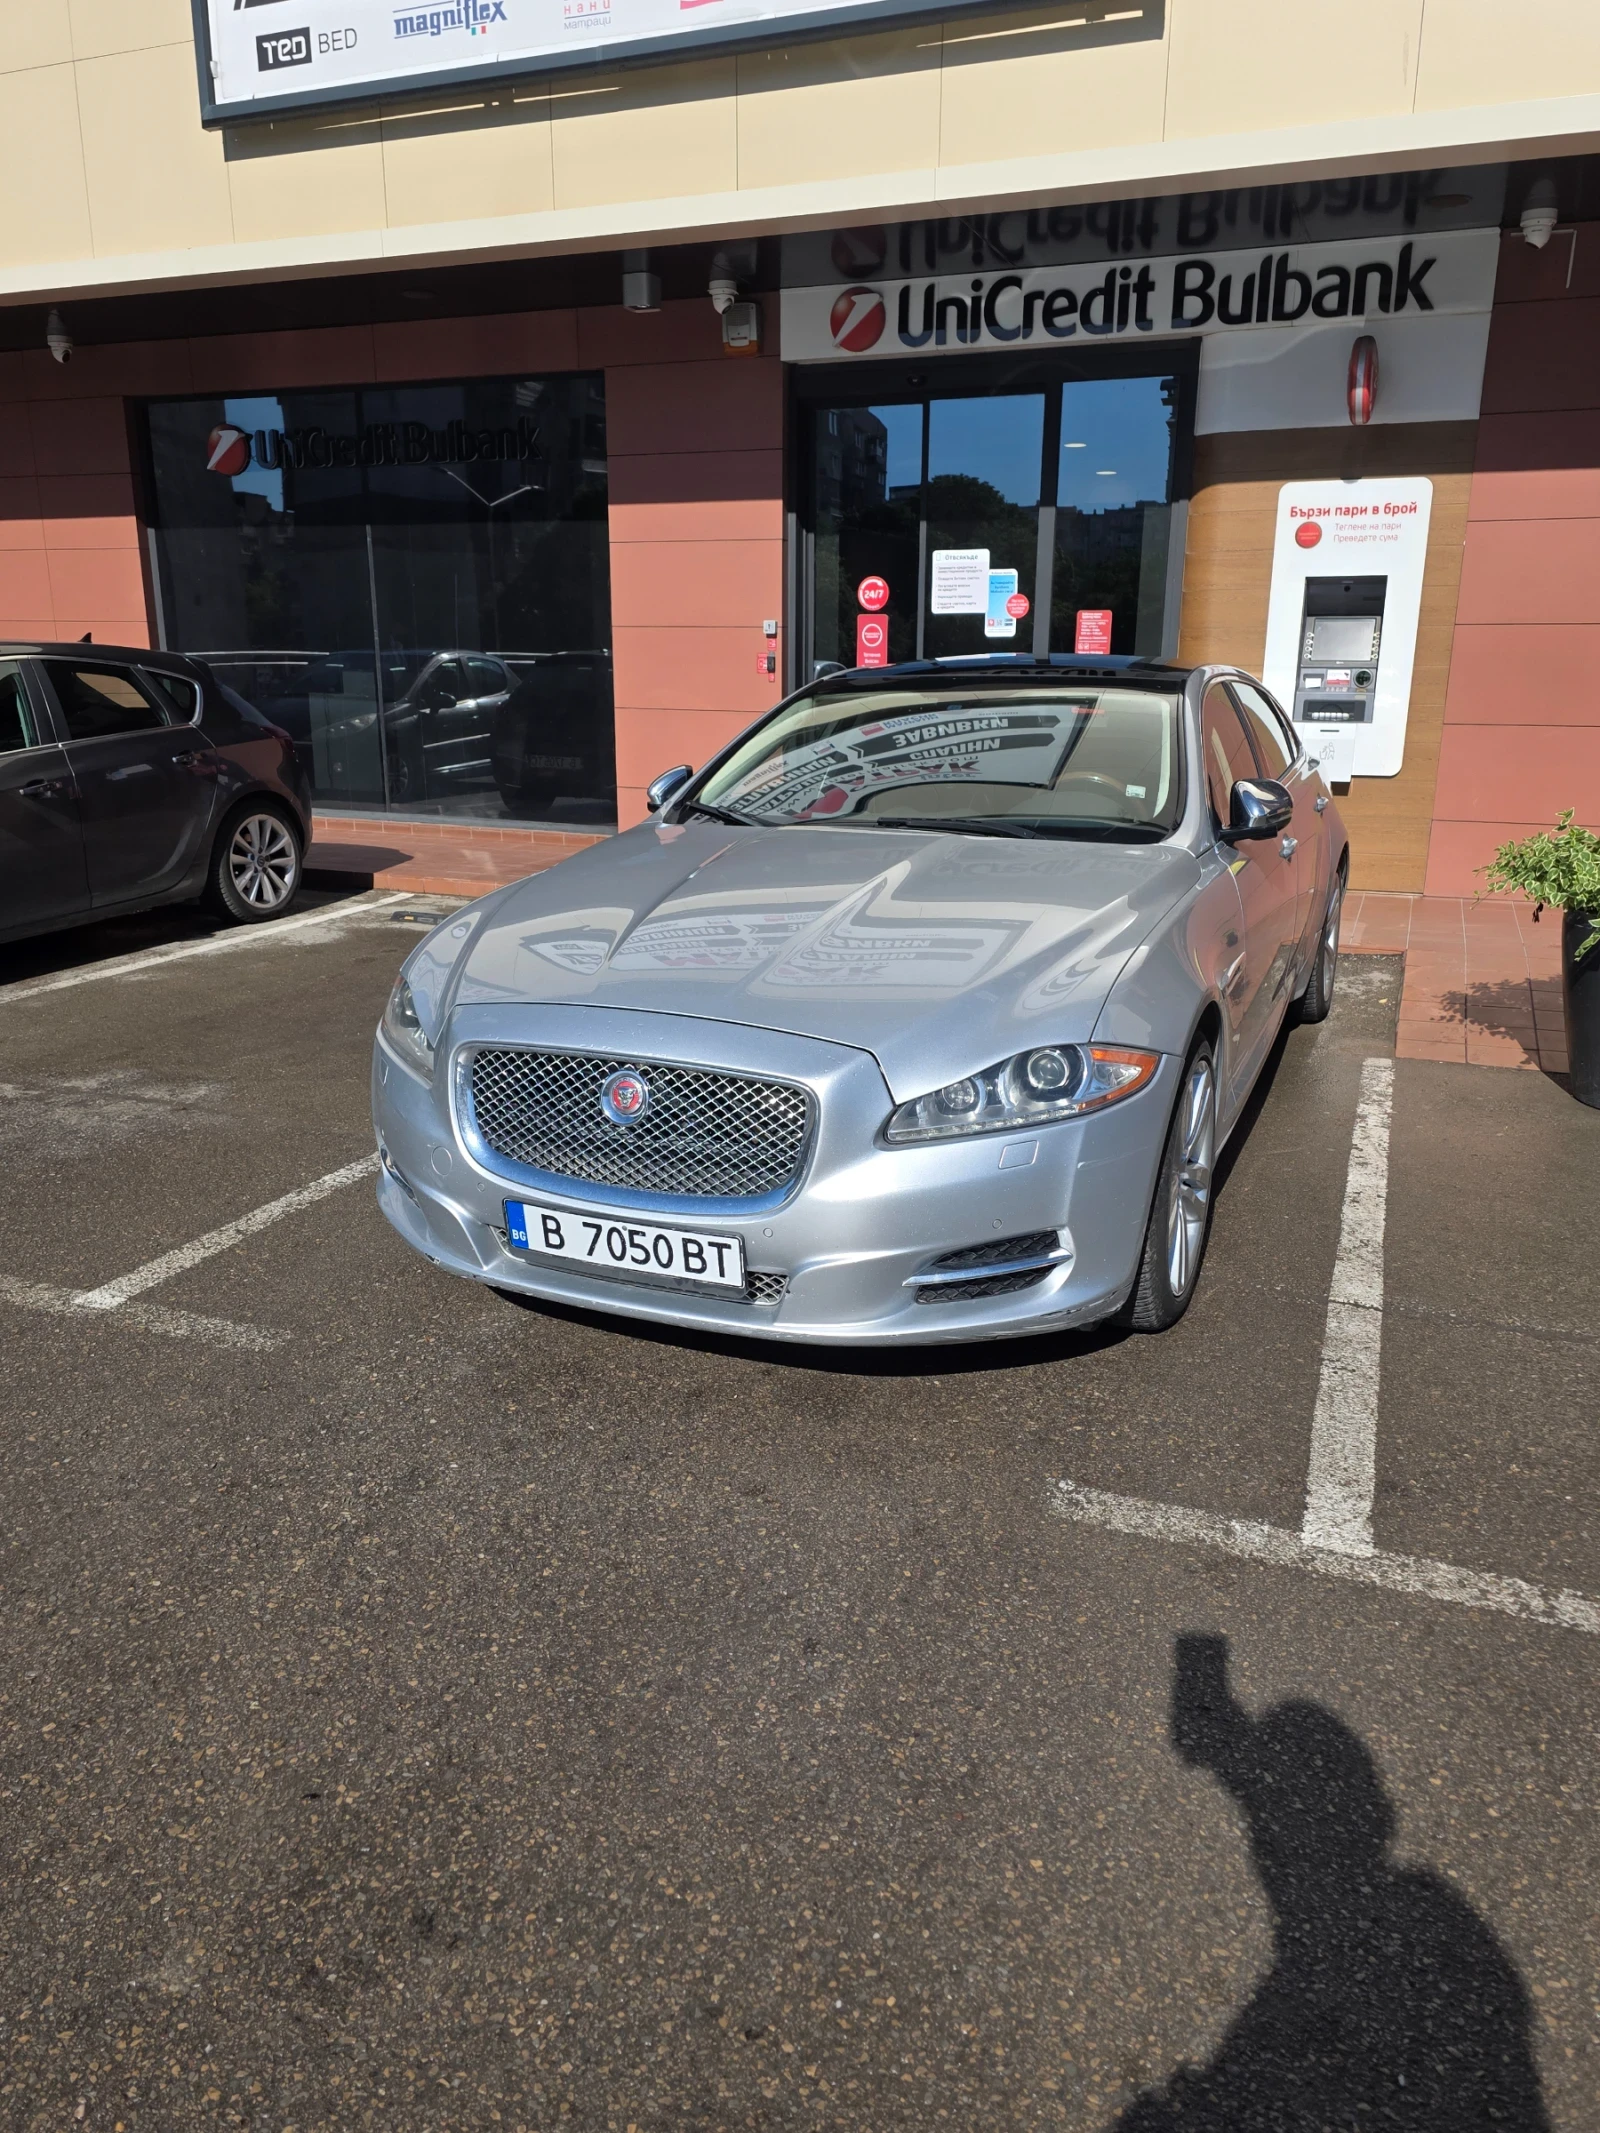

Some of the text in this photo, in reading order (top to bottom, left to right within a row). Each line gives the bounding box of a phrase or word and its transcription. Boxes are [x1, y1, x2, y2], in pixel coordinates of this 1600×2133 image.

[393, 0, 508, 36] magniflex
[317, 28, 358, 54] BED
[898, 241, 1437, 348] UniCredit Bulbank
[254, 416, 543, 469] UniCredit Bulbank
[1290, 502, 1418, 519] Бързи пари в брой
[1335, 522, 1402, 531] Теглене на пари
[1334, 534, 1399, 543] Преведете сума
[864, 589, 884, 599] 24/7
[512, 1228, 527, 1241] BG
[541, 1213, 732, 1278] B 7050 BT
